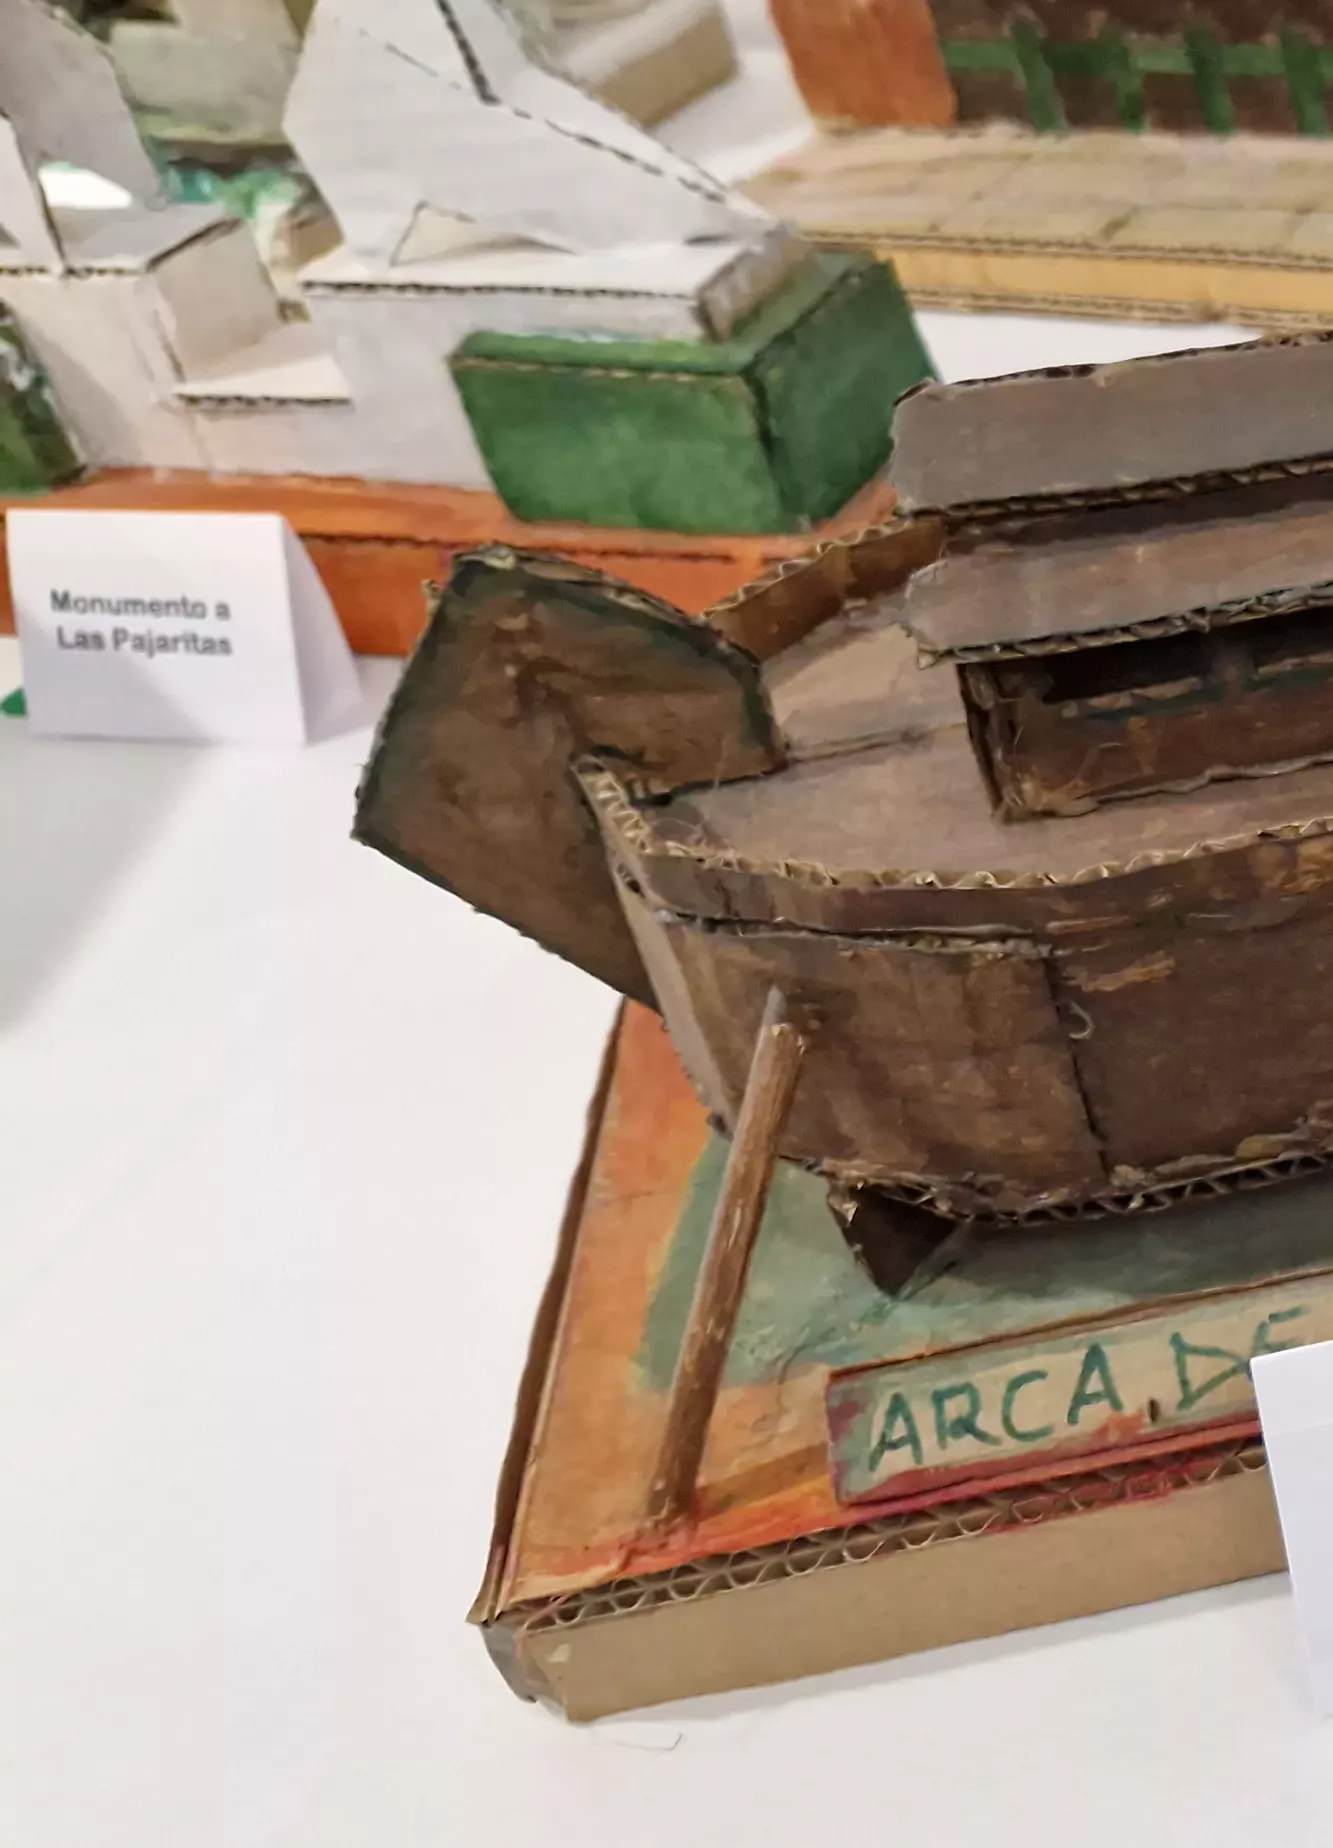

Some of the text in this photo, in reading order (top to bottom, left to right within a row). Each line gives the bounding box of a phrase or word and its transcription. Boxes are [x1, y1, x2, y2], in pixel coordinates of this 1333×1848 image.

[51, 590, 231, 620] Monumento a
[57, 626, 232, 659] Las Pajaritas
[868, 1343, 1123, 1472] ARCA
